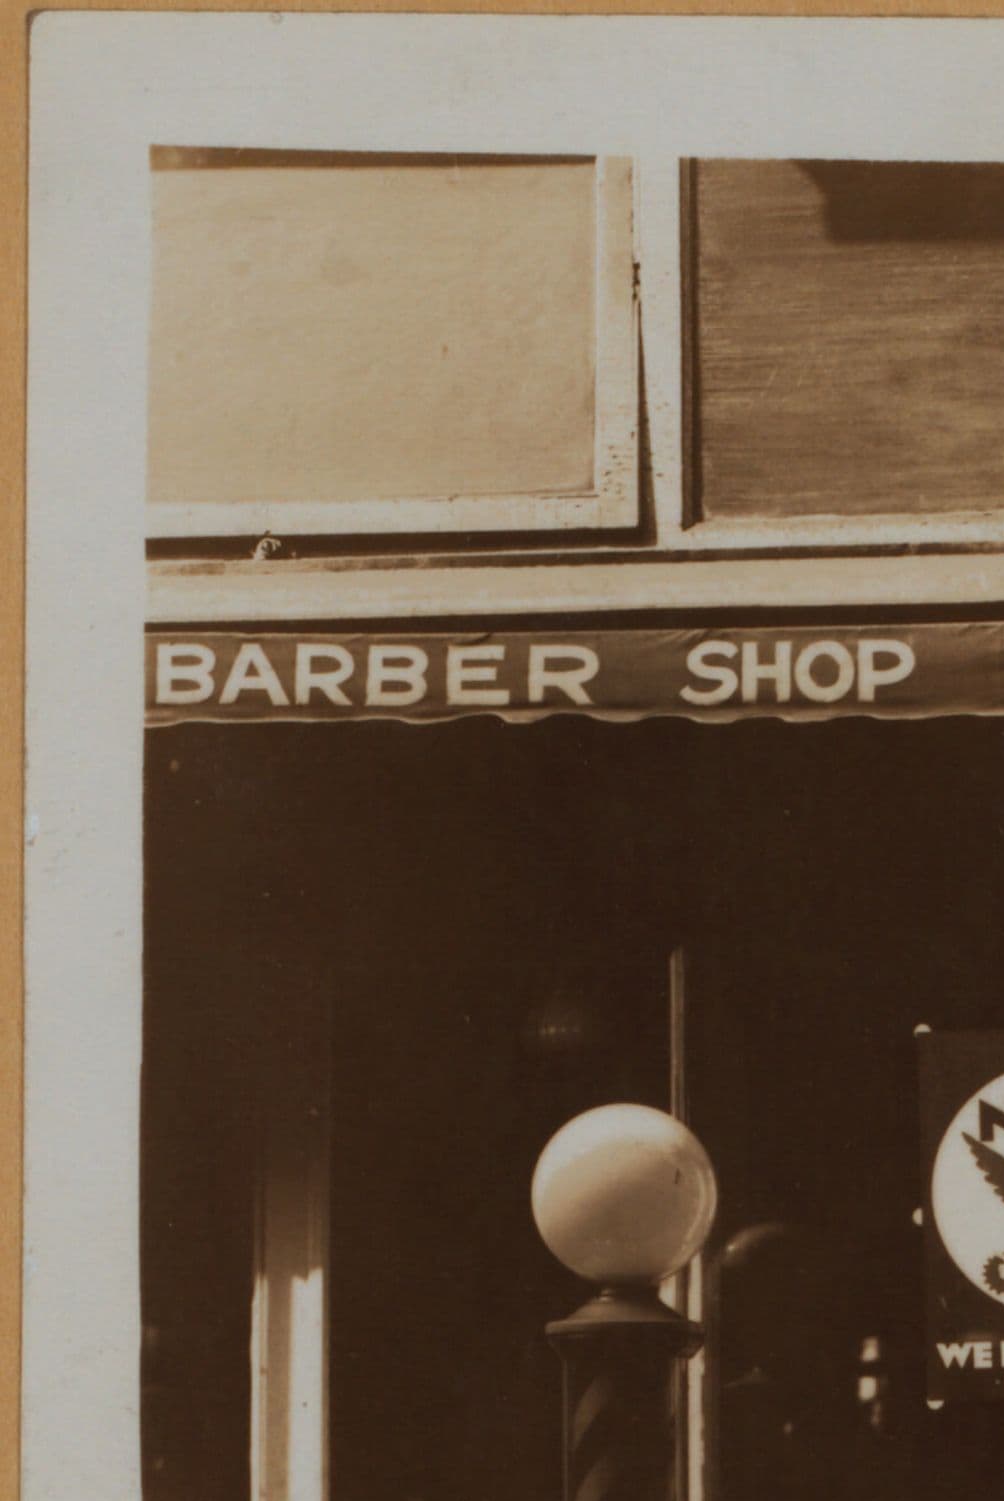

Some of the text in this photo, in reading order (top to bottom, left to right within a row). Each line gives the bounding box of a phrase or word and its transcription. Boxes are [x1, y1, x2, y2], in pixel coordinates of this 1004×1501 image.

[154, 642, 600, 705] BARBER
[680, 639, 916, 705] SHOP
[937, 1341, 993, 1369] WE
